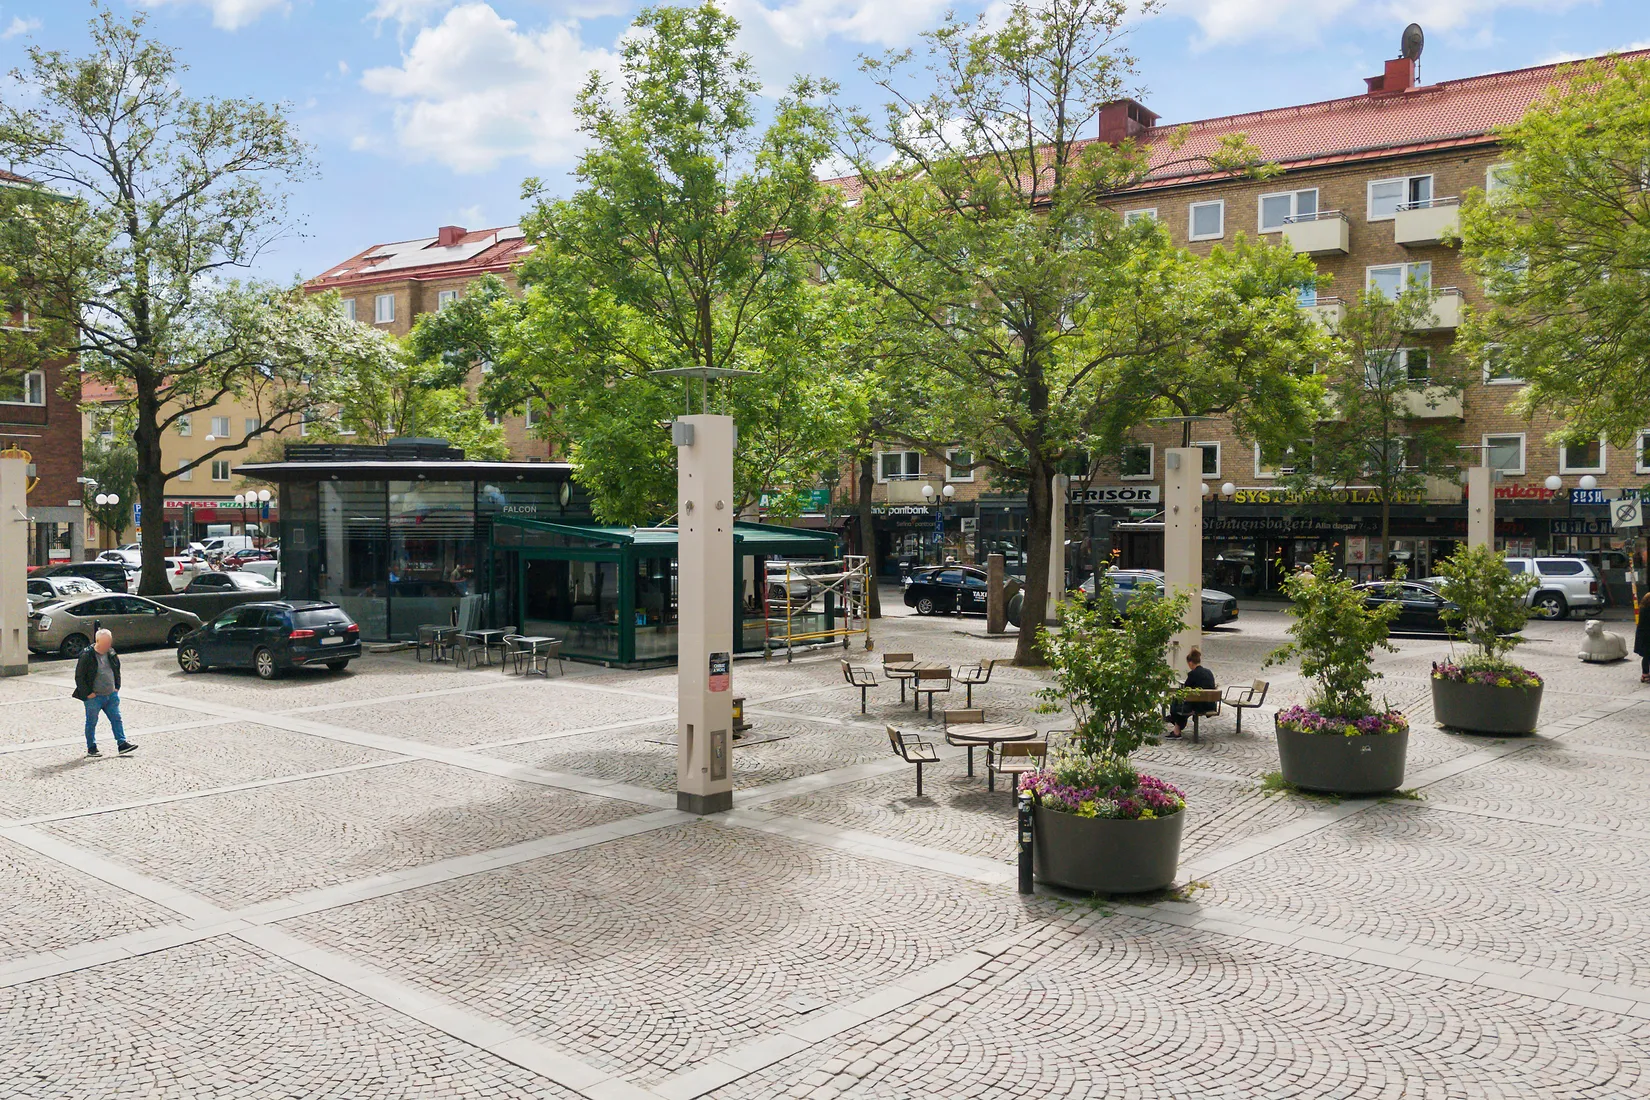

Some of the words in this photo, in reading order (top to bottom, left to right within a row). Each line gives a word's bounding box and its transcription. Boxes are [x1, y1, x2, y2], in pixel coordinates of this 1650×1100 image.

[1072, 487, 1152, 500] FRISÖR
[1573, 490, 1607, 503] SUSH
[503, 505, 537, 513] FALCON
[888, 505, 930, 516] pantbank
[1332, 522, 1357, 531] dagar
